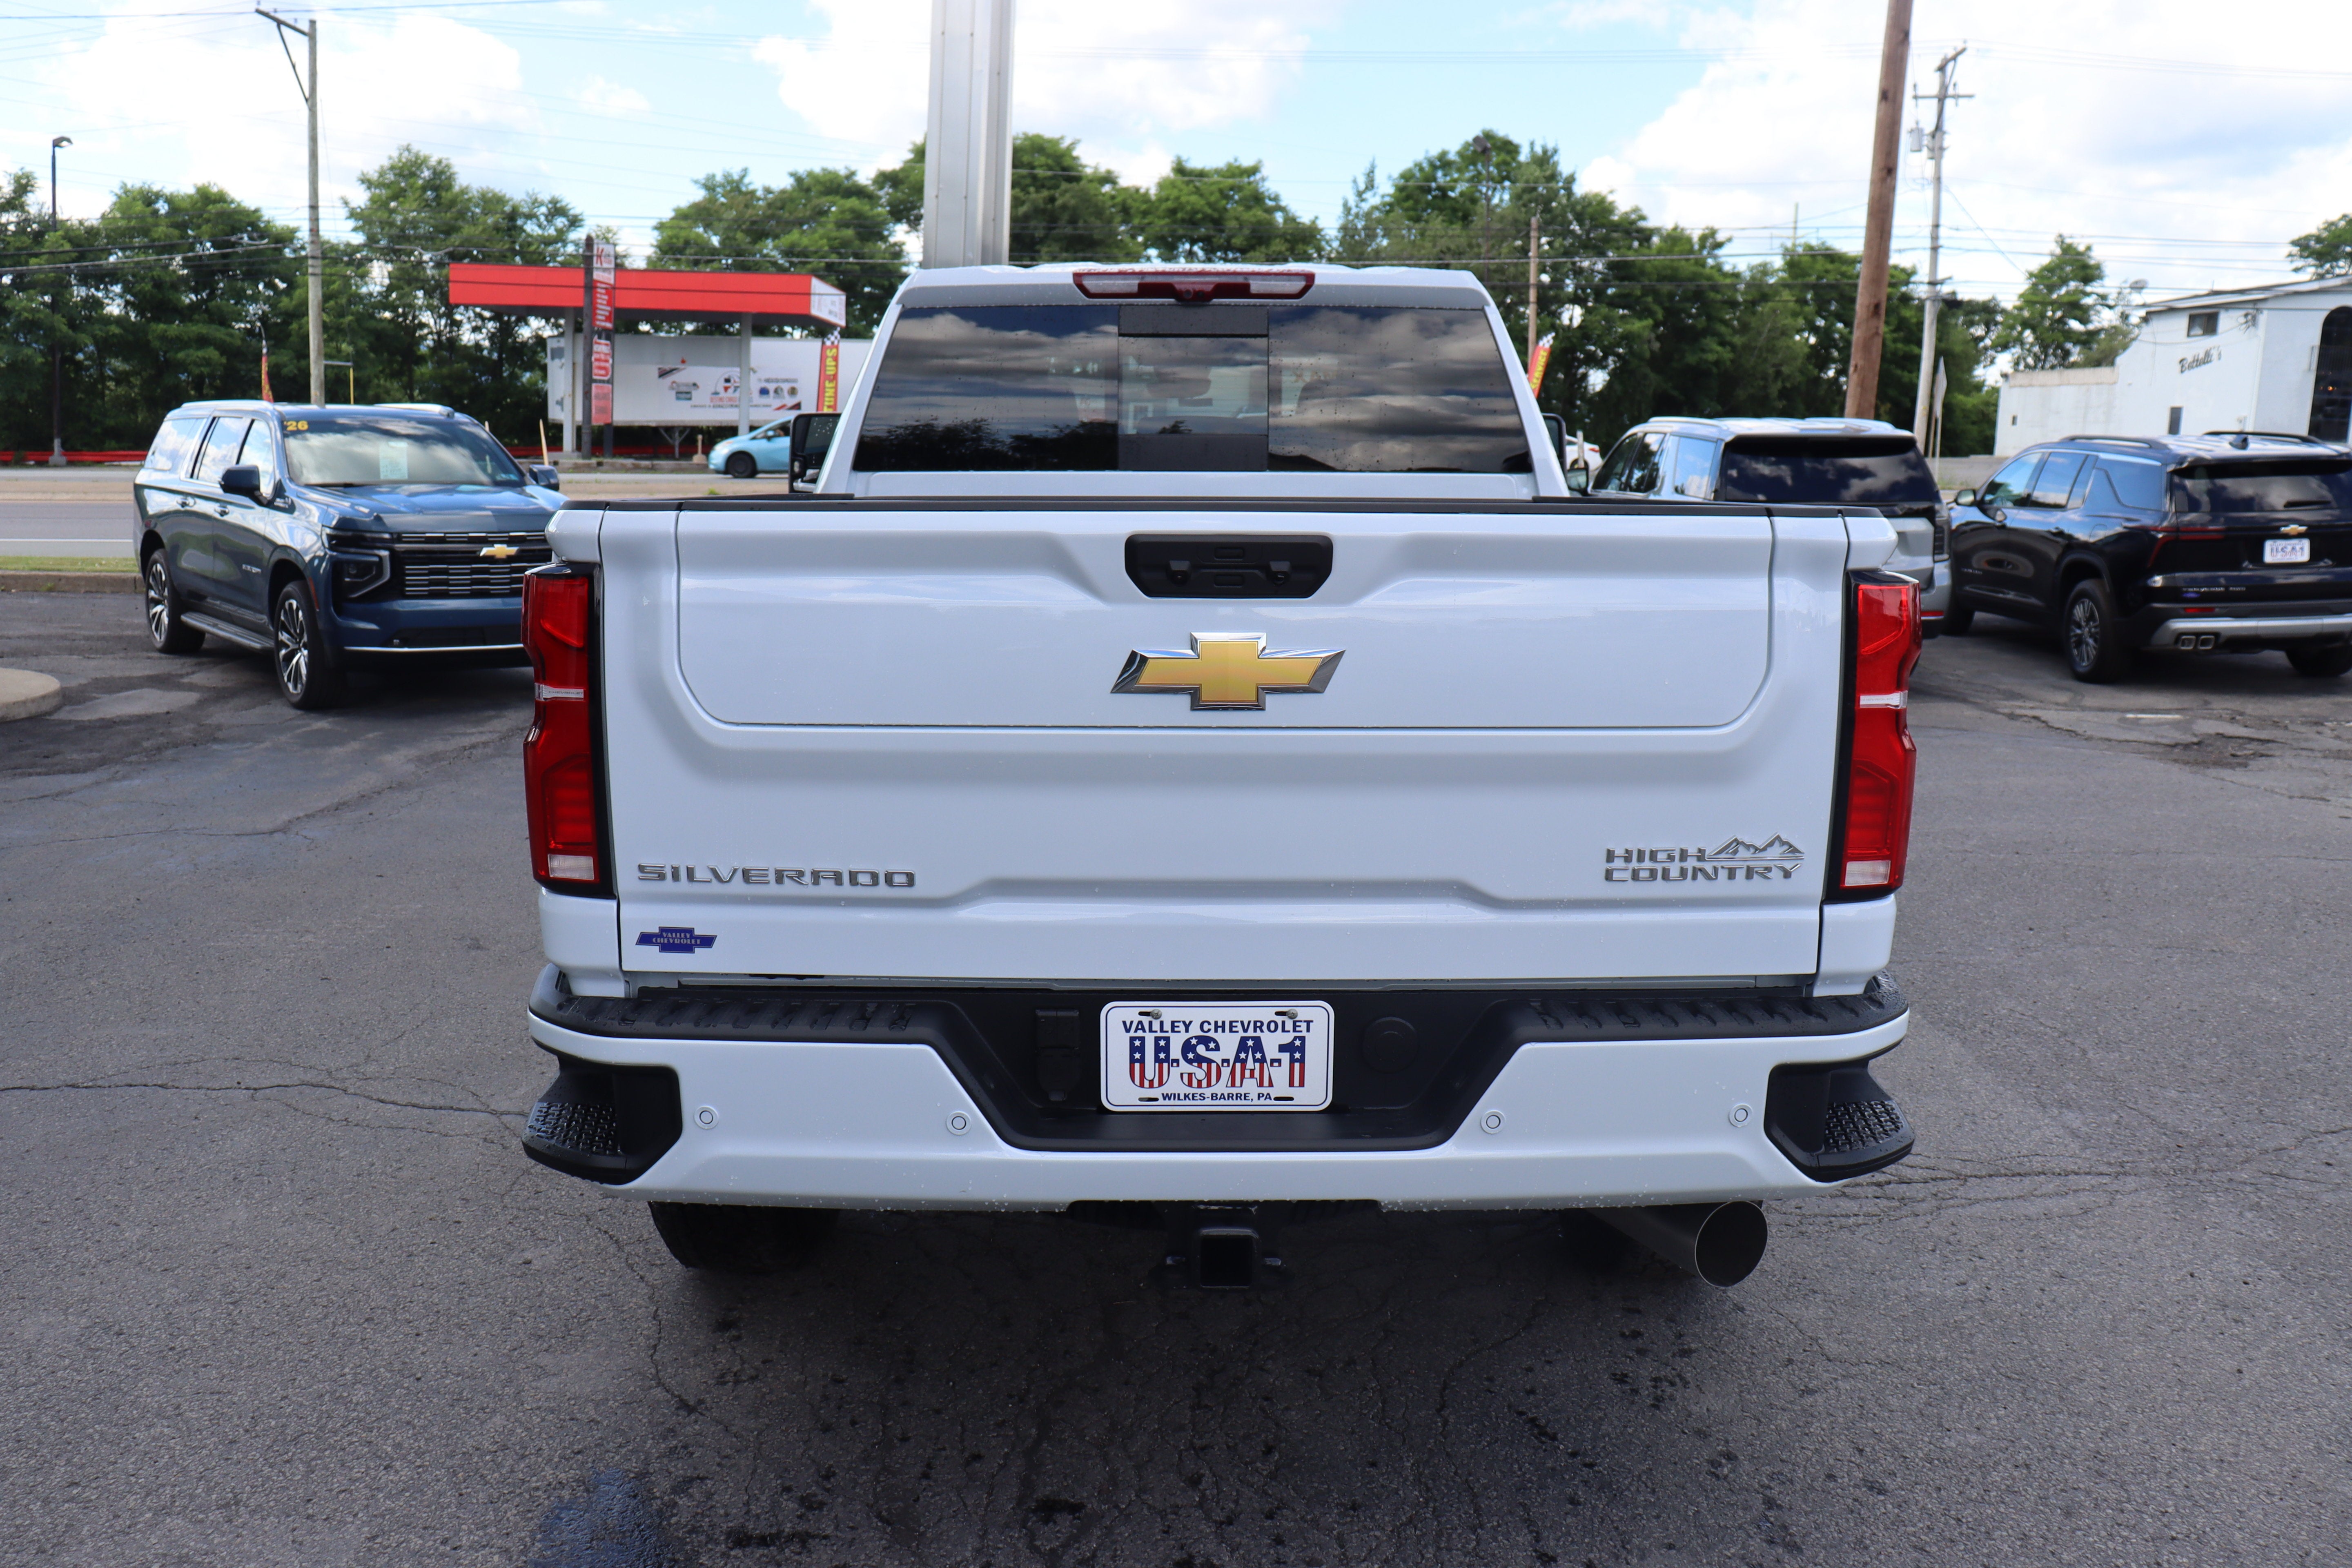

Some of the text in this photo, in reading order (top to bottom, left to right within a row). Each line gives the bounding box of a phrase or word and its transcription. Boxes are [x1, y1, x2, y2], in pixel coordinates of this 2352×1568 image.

[823, 348, 837, 412] TUNE-UPS
[1606, 847, 1707, 863] HIGH
[638, 863, 916, 887] SILVERADO
[1605, 863, 1803, 881] COUNTRY
[1122, 1020, 1314, 1033] VALLEY CHEVROLET
[1161, 1092, 1272, 1102] WILKES-BARRE, PA
